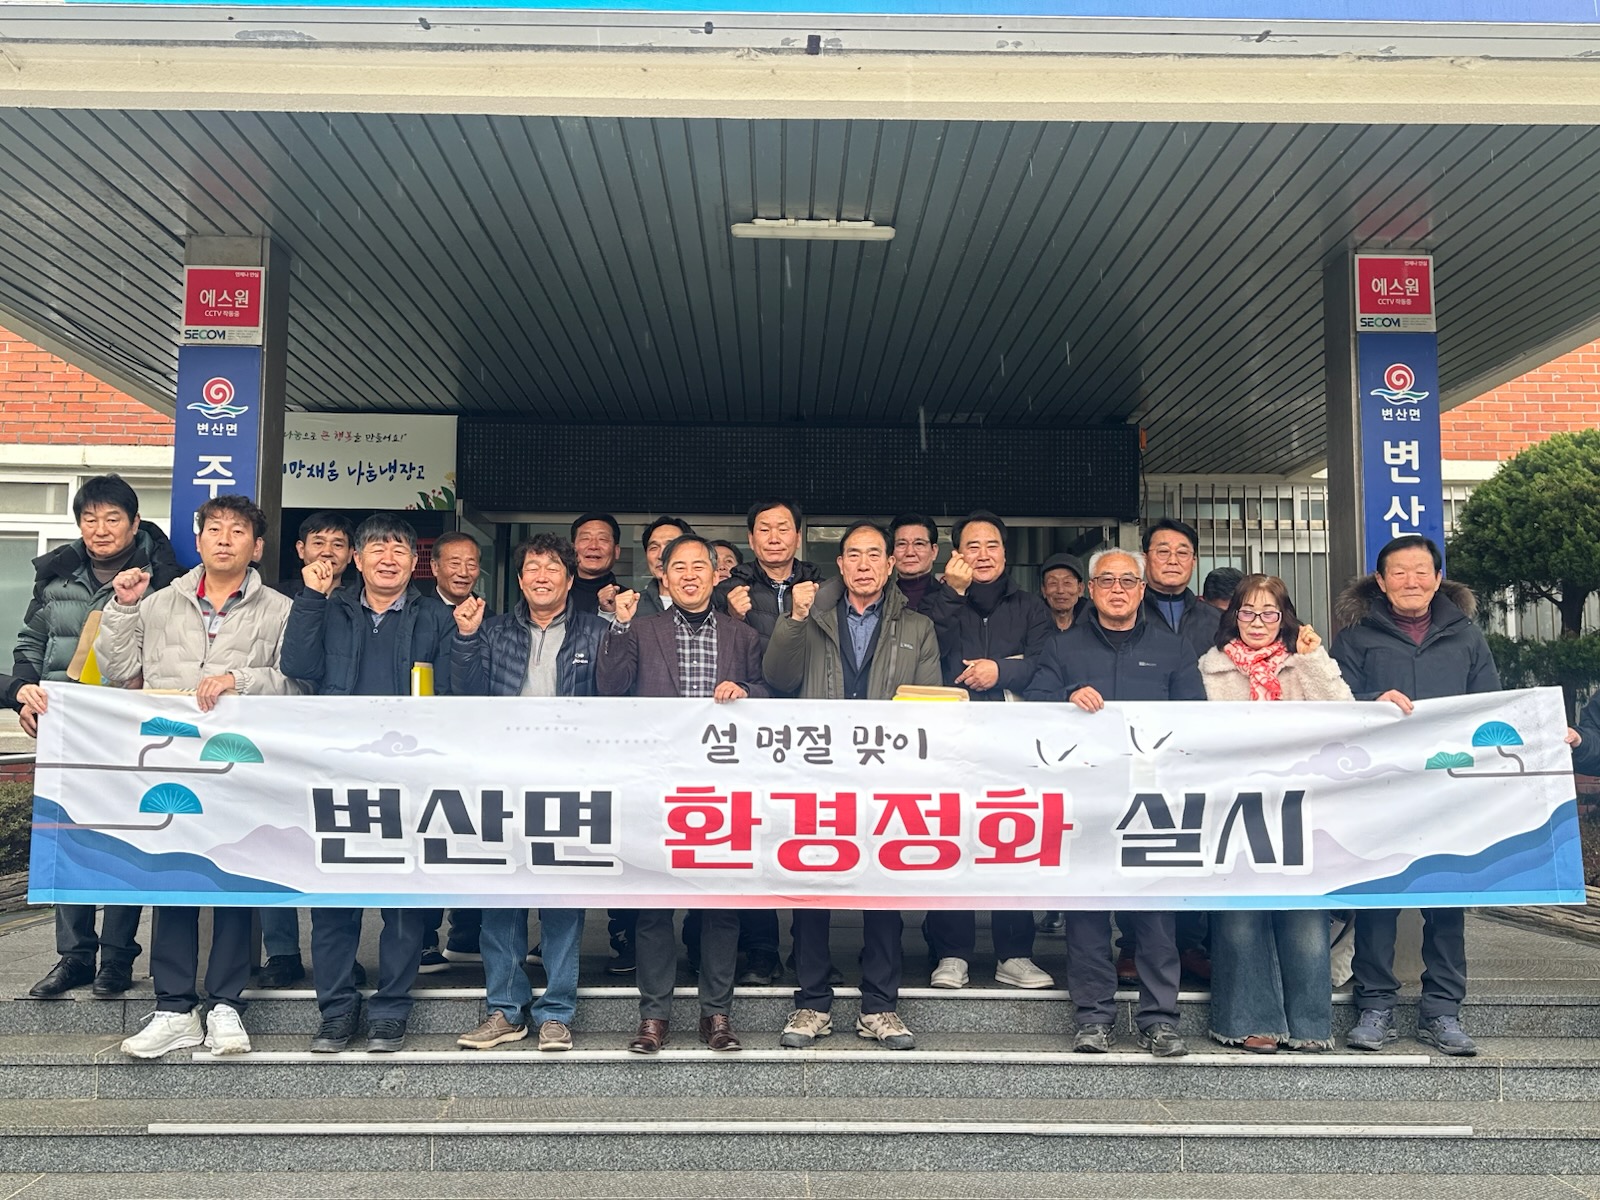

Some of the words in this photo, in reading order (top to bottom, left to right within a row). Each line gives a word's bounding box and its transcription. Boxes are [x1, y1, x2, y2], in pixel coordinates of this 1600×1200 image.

[1371, 278, 1419, 296] 에스원
[200, 289, 249, 308] 에스원
[204, 309, 222, 317] CCTV
[1360, 317, 1401, 328] SECOM
[184, 329, 226, 340] SECOM
[1381, 408, 1421, 421] 변산면
[196, 422, 238, 437] 변산면
[283, 459, 340, 482] 망채움
[347, 458, 425, 486] 나눔냉장고
[701, 722, 740, 764] 설
[756, 724, 834, 765] 명절
[852, 724, 928, 765] 맞이
[311, 786, 615, 867] 변산면
[664, 786, 1074, 871] 환경정화
[1115, 790, 1306, 868] 실시
